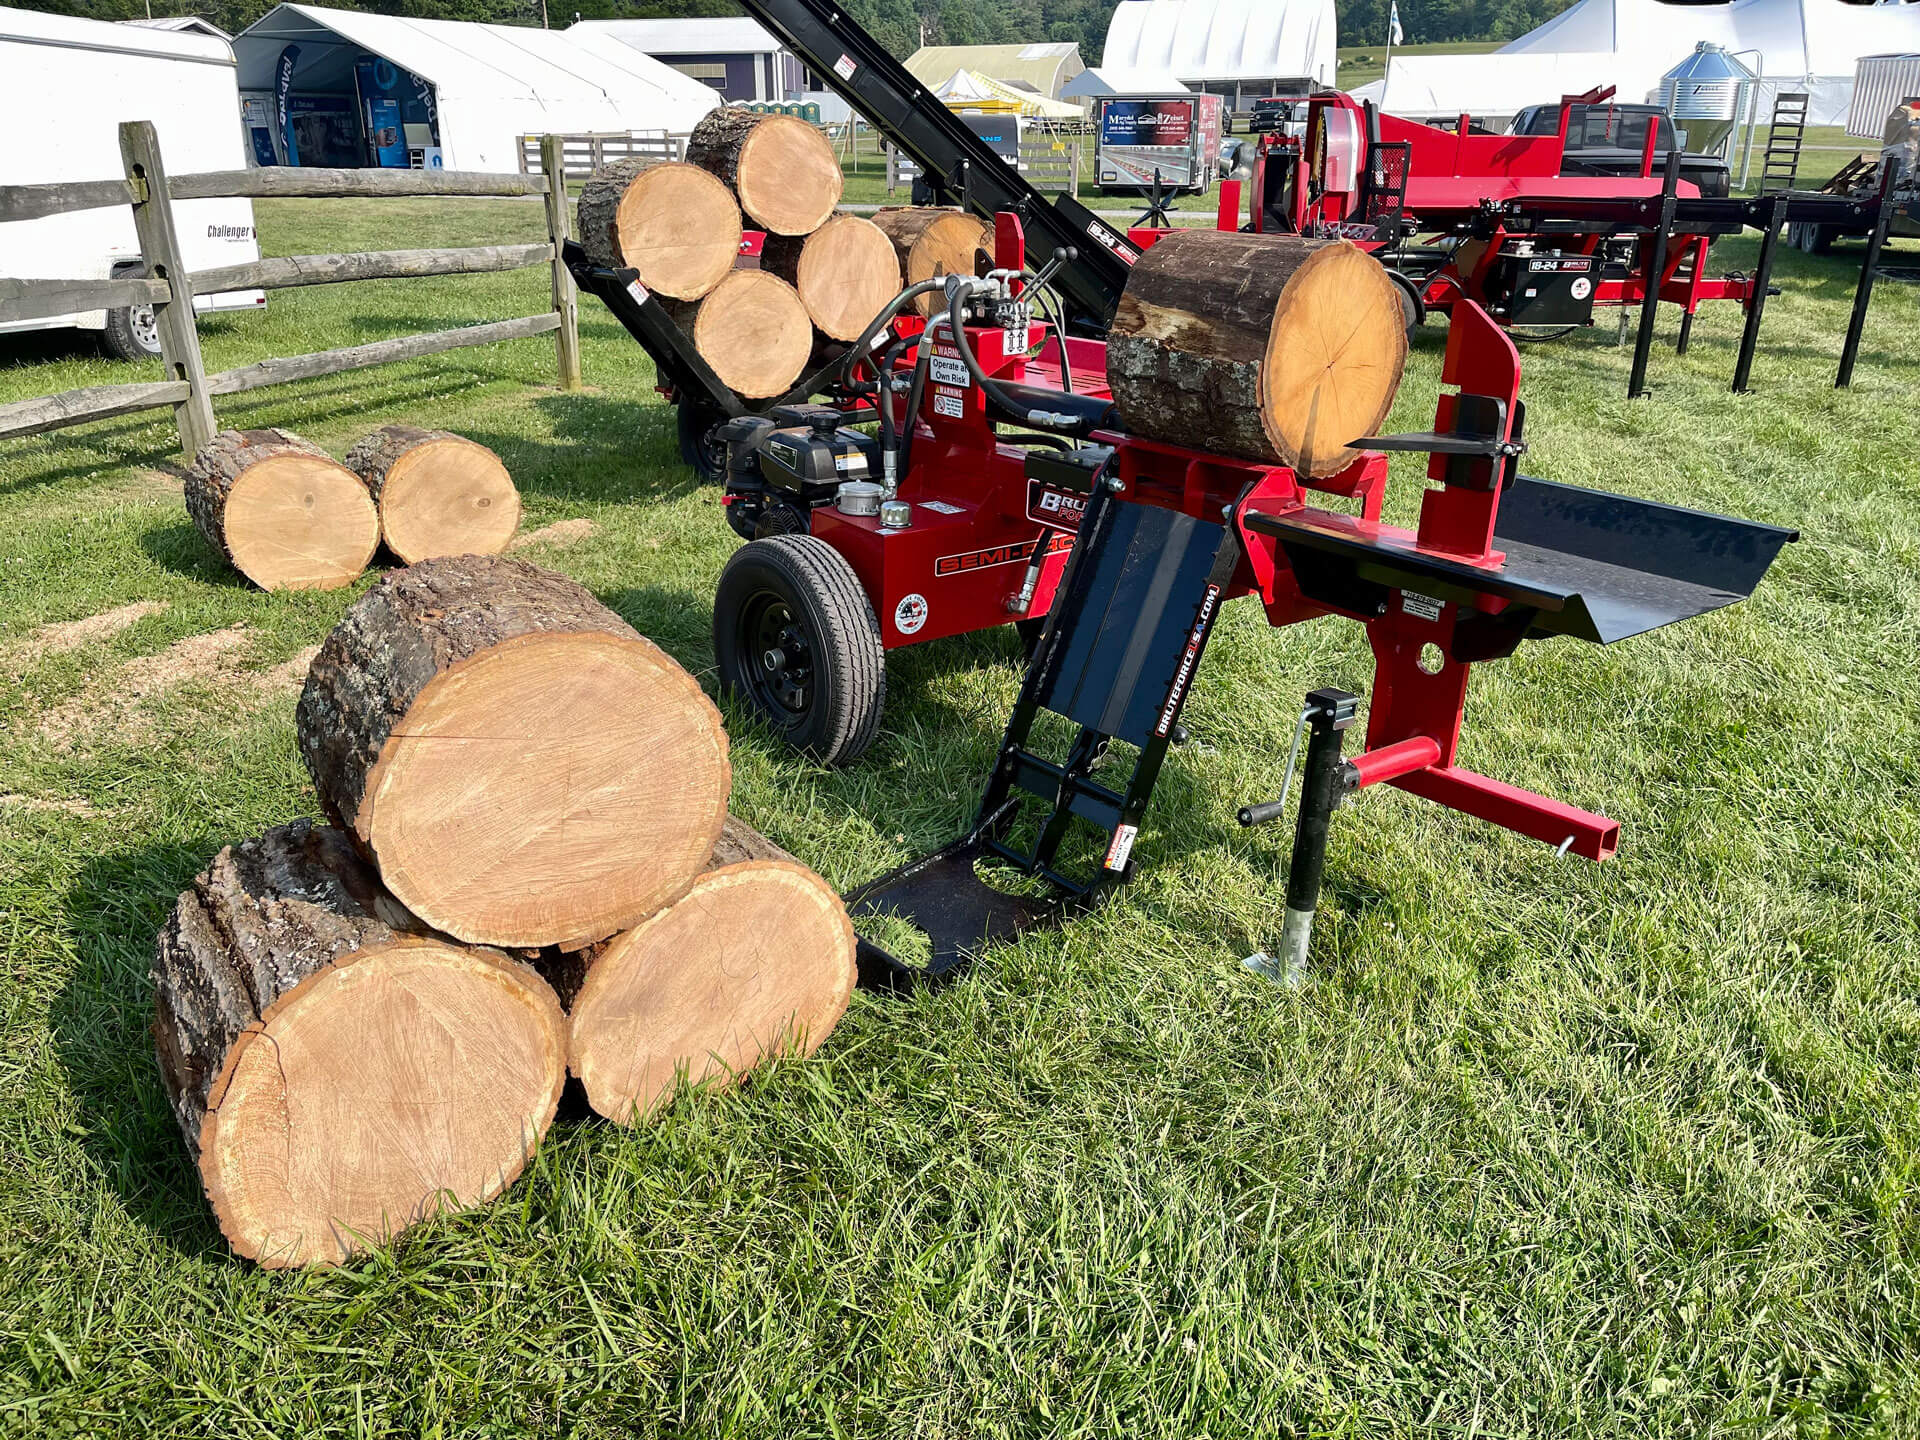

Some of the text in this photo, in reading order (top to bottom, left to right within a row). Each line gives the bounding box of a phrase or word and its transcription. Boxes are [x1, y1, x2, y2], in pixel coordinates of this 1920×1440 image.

[207, 225, 250, 239] Challenger
[1531, 261, 1558, 271] 18-24
[938, 345, 961, 359] WARN
[933, 358, 969, 373] Operate at
[936, 370, 966, 384] Own Risk
[940, 385, 963, 398] WARNING
[1040, 492, 1088, 512] BRU
[1158, 588, 1219, 735] BRUTEFORCEUSA.COM
